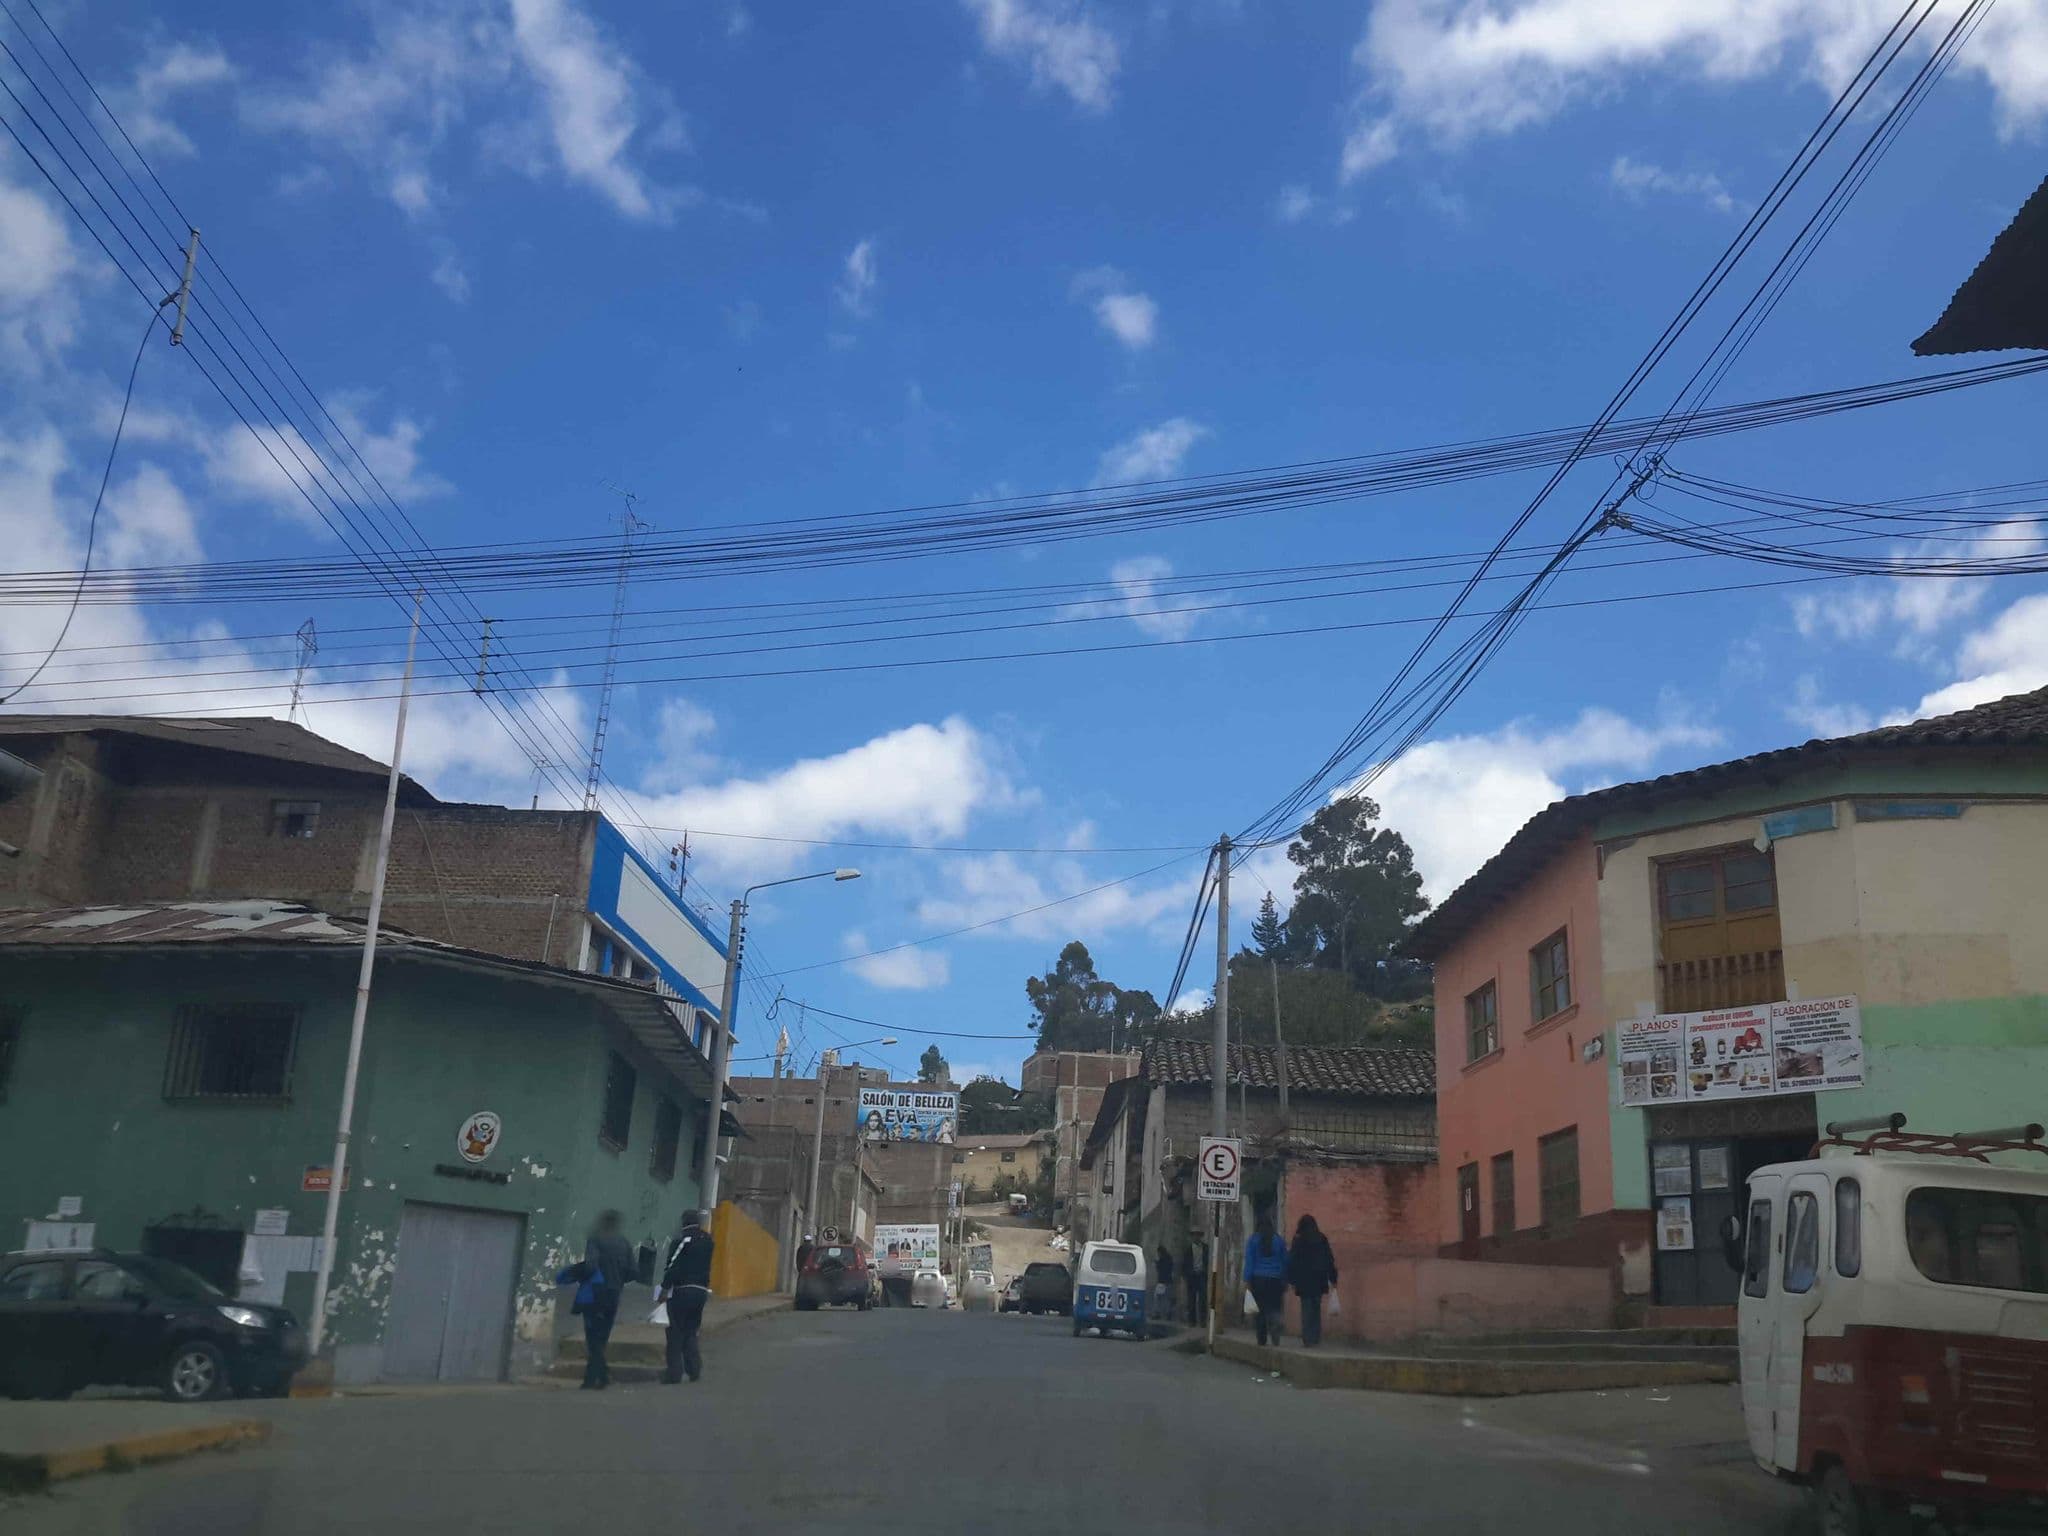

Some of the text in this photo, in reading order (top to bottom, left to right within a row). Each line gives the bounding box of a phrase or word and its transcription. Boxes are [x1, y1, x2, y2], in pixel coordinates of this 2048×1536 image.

[1773, 999, 1853, 1017] ELABORACION DE:
[1632, 1020, 1678, 1032] PLANOS
[862, 1090, 954, 1109] SALÓN DE BELLEZA
[885, 1109, 918, 1124] EVA
[1214, 1154, 1225, 1171] E
